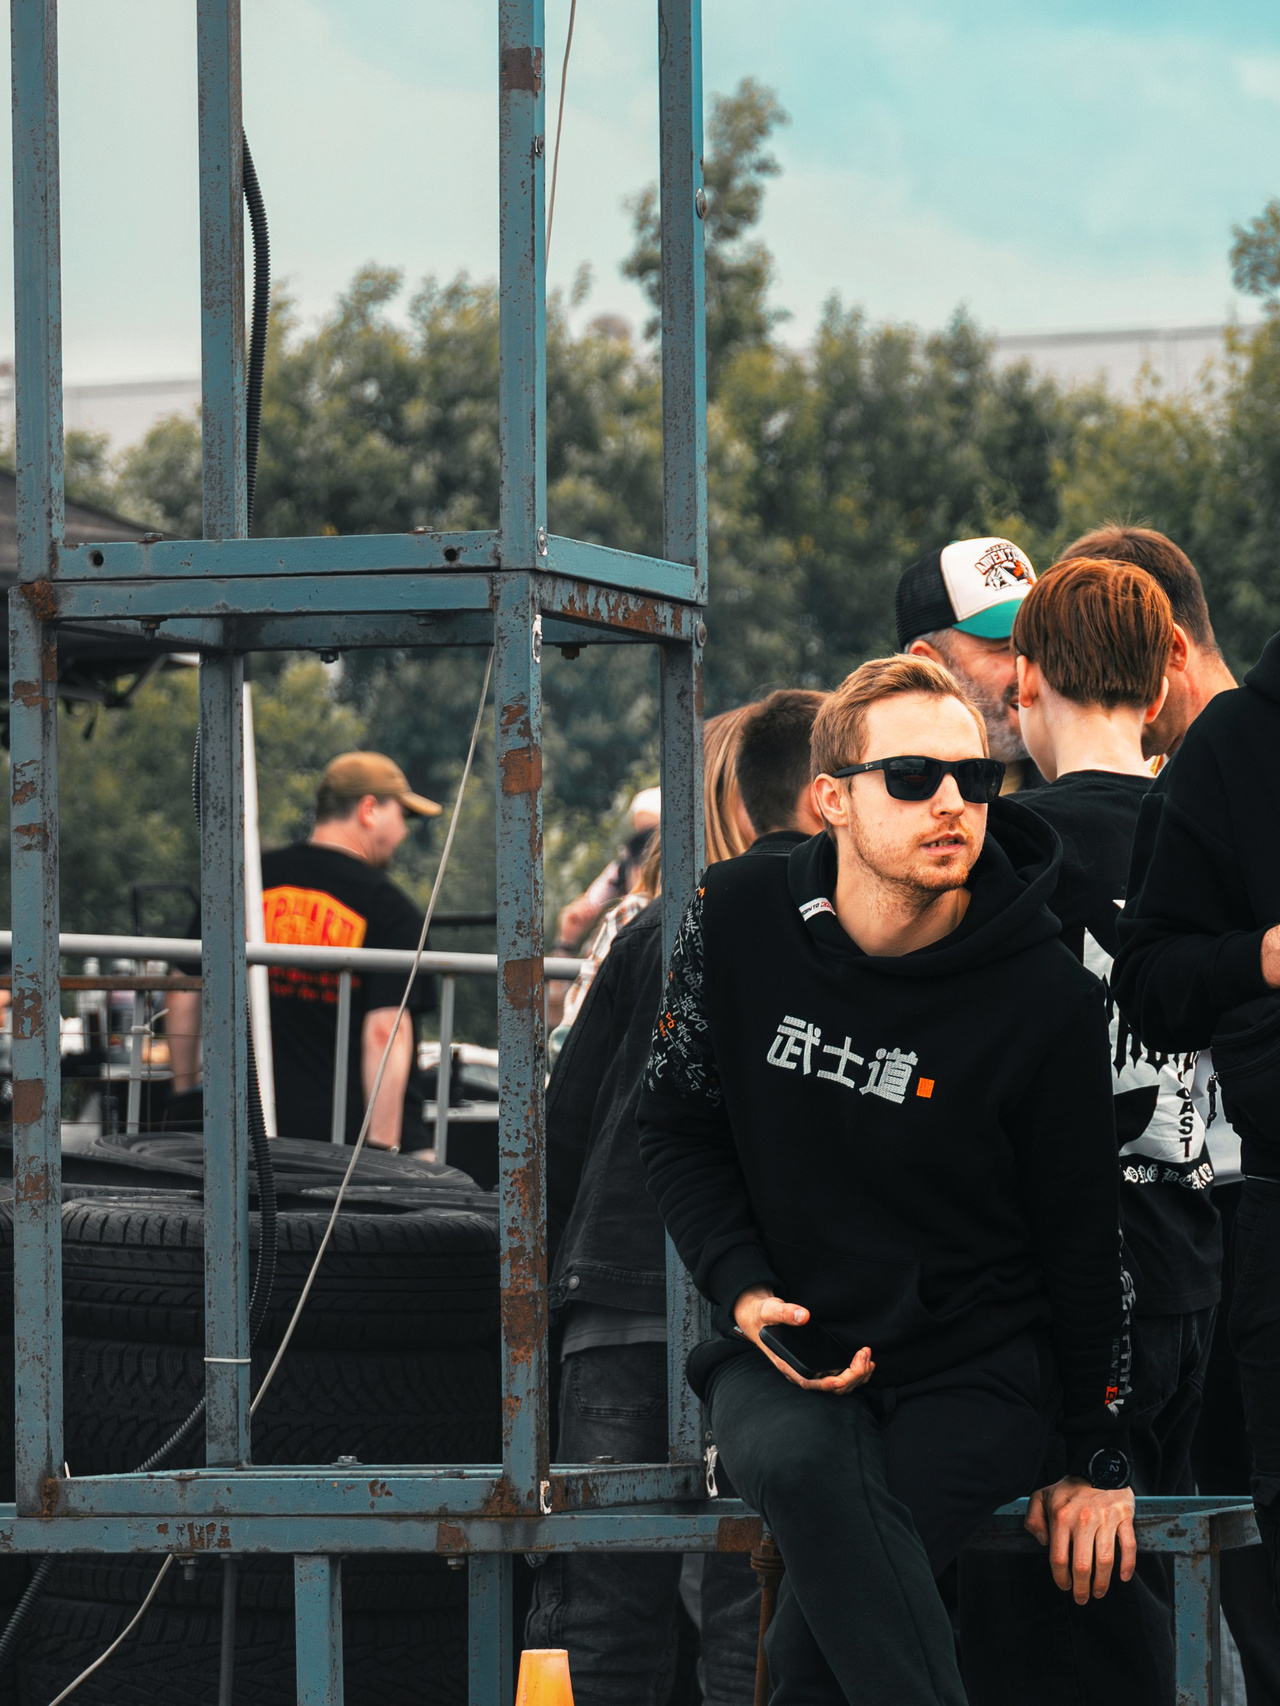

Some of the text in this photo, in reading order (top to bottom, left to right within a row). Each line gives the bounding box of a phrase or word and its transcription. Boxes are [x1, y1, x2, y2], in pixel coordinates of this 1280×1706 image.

[766, 1014, 919, 1104] 武士道
[1120, 1163, 1158, 1184] ONG
